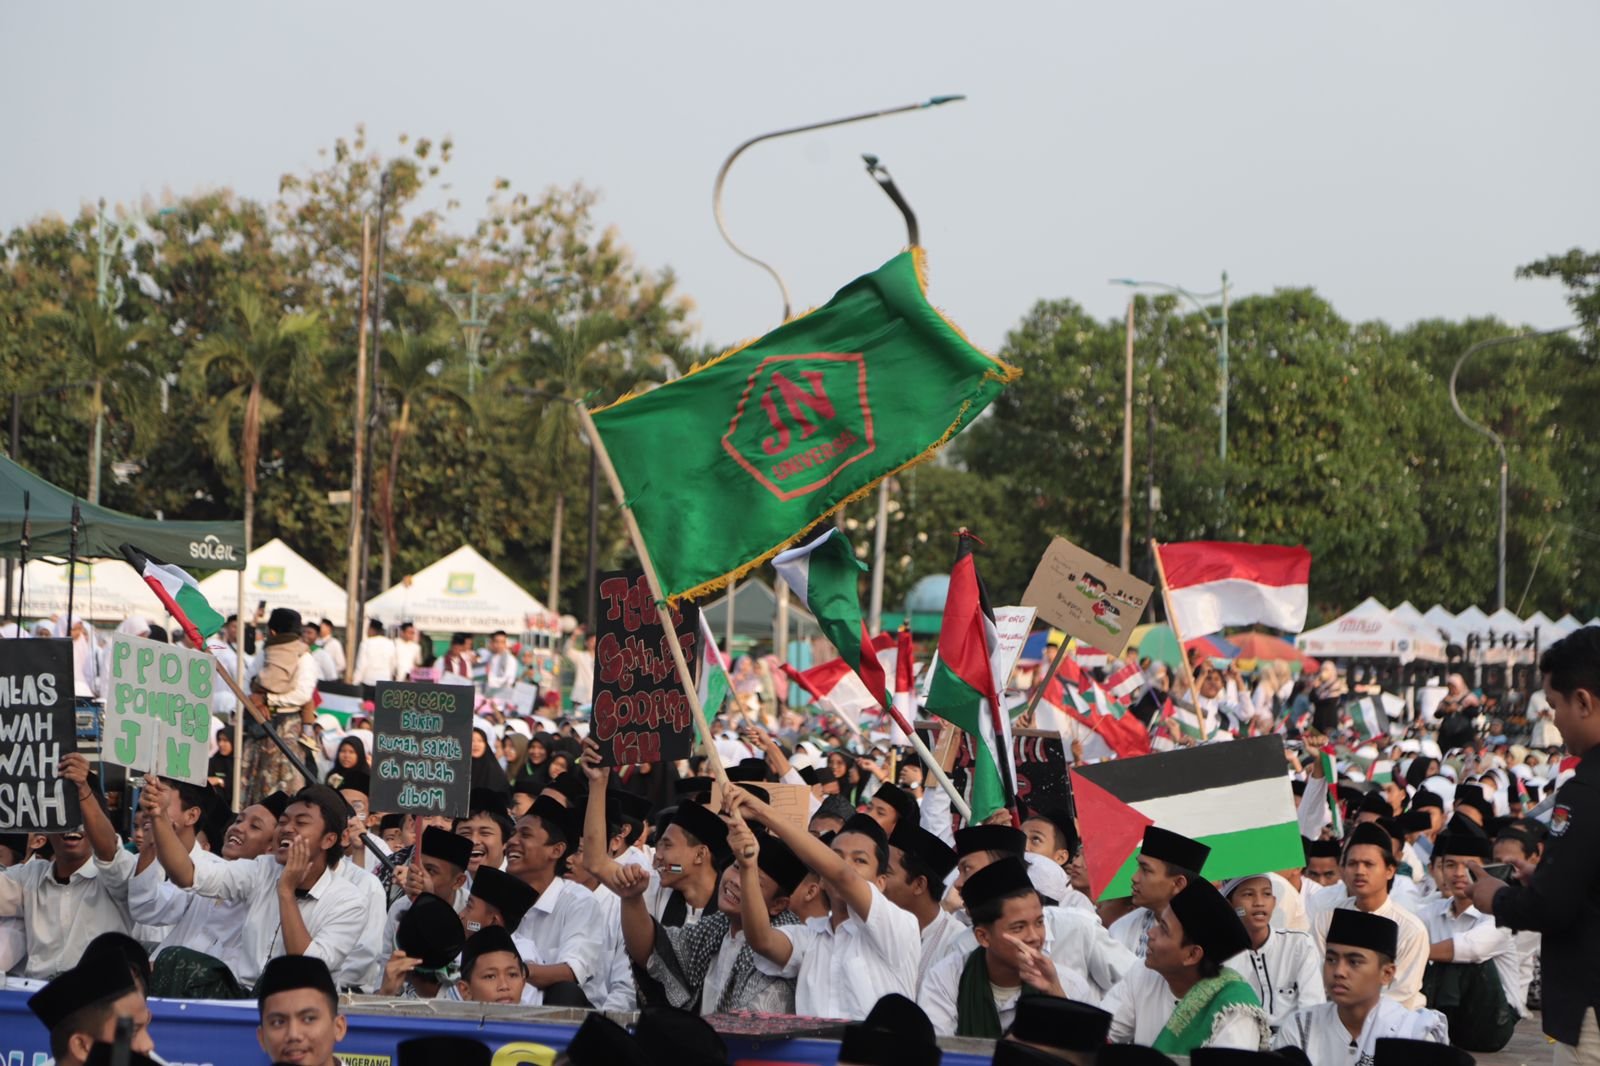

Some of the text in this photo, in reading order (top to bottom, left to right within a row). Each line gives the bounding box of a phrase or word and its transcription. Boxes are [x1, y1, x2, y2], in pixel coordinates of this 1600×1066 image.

[760, 370, 836, 456] JN
[771, 428, 859, 481] UNIVERSAL
[341, 1056, 389, 1066] NGERANG
